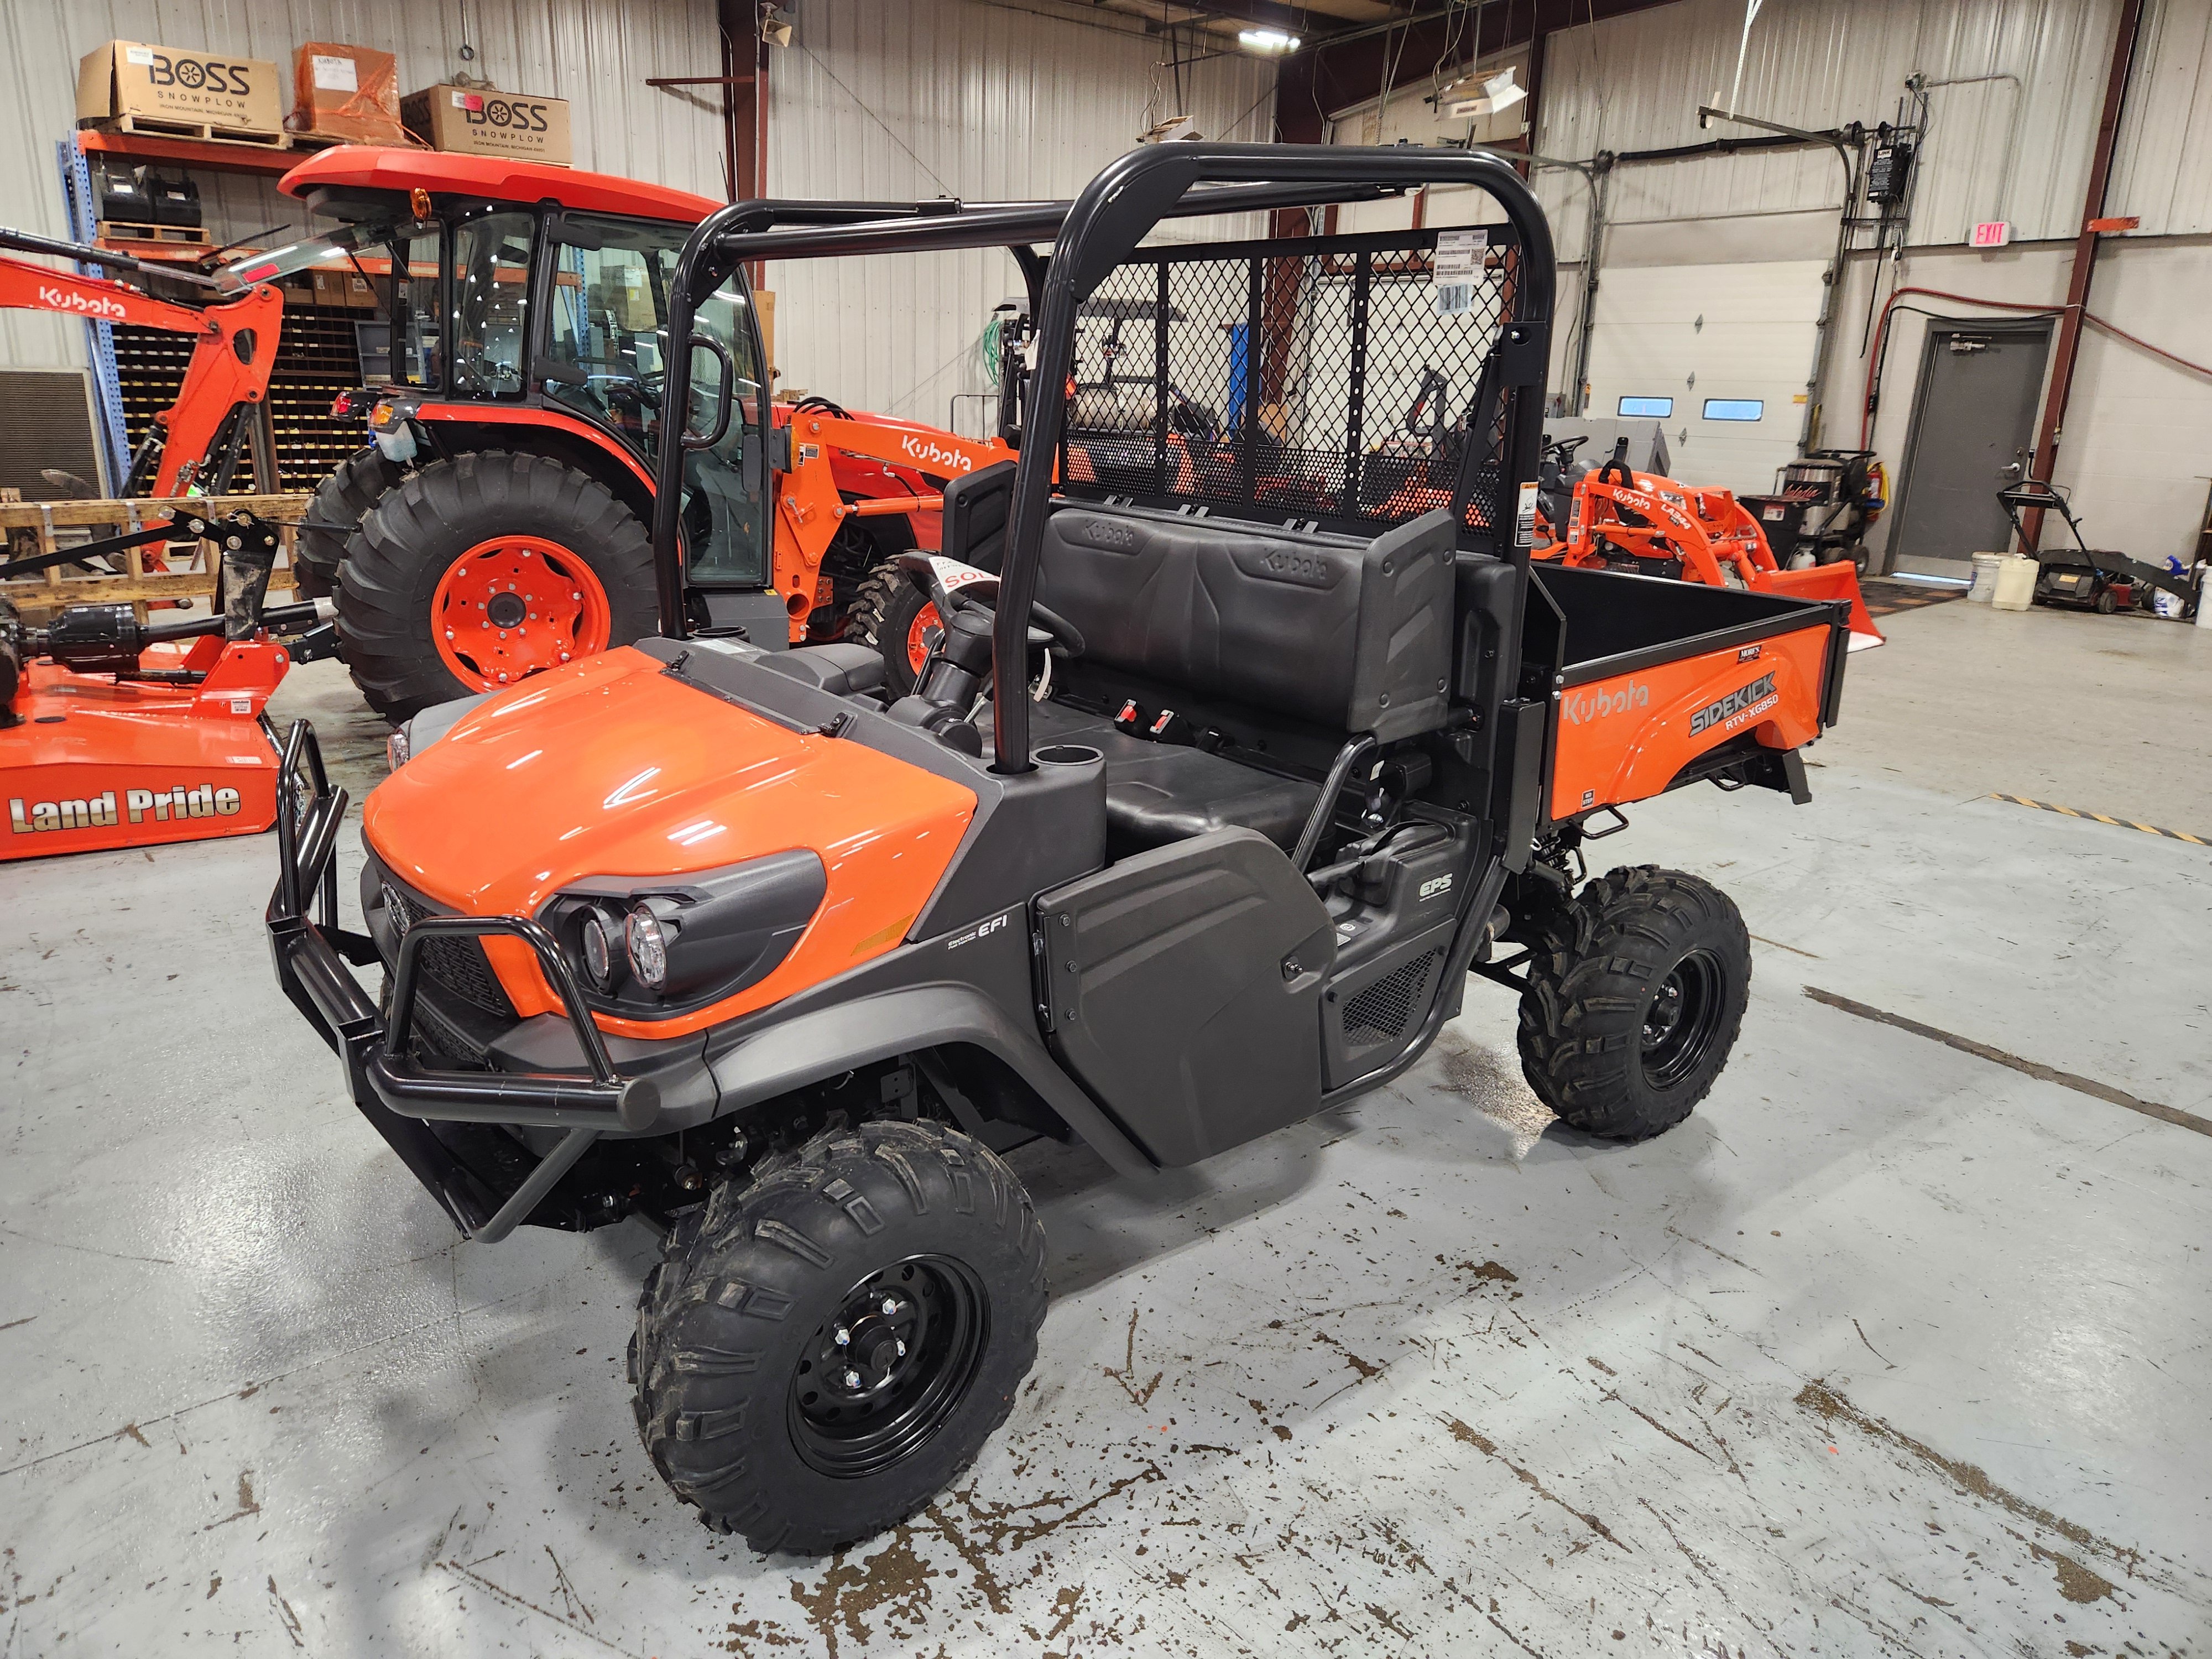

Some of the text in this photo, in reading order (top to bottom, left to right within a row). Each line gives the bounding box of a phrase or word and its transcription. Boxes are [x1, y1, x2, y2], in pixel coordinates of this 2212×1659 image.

[148, 54, 250, 96] BOSS
[157, 91, 245, 108] SNOWPLOW
[465, 100, 548, 132] BOSS
[472, 129, 544, 144] SNOWPLOW
[1976, 223, 2005, 244] EXIT
[39, 286, 126, 318] Kubota
[901, 434, 972, 471] Kubota
[1613, 488, 1651, 510] Kubota
[1661, 504, 1692, 530] LA344
[1082, 519, 1135, 546] Kubota
[1261, 547, 1327, 580] Kubota
[945, 572, 999, 588] SOL
[1563, 680, 1649, 726] Kubota
[1689, 670, 1777, 737] SIDEKICK
[1725, 694, 1779, 731] RTV-XG850
[9, 783, 241, 834] Land Pride
[1419, 873, 1453, 897] EPS
[978, 914, 1008, 937] EFI
